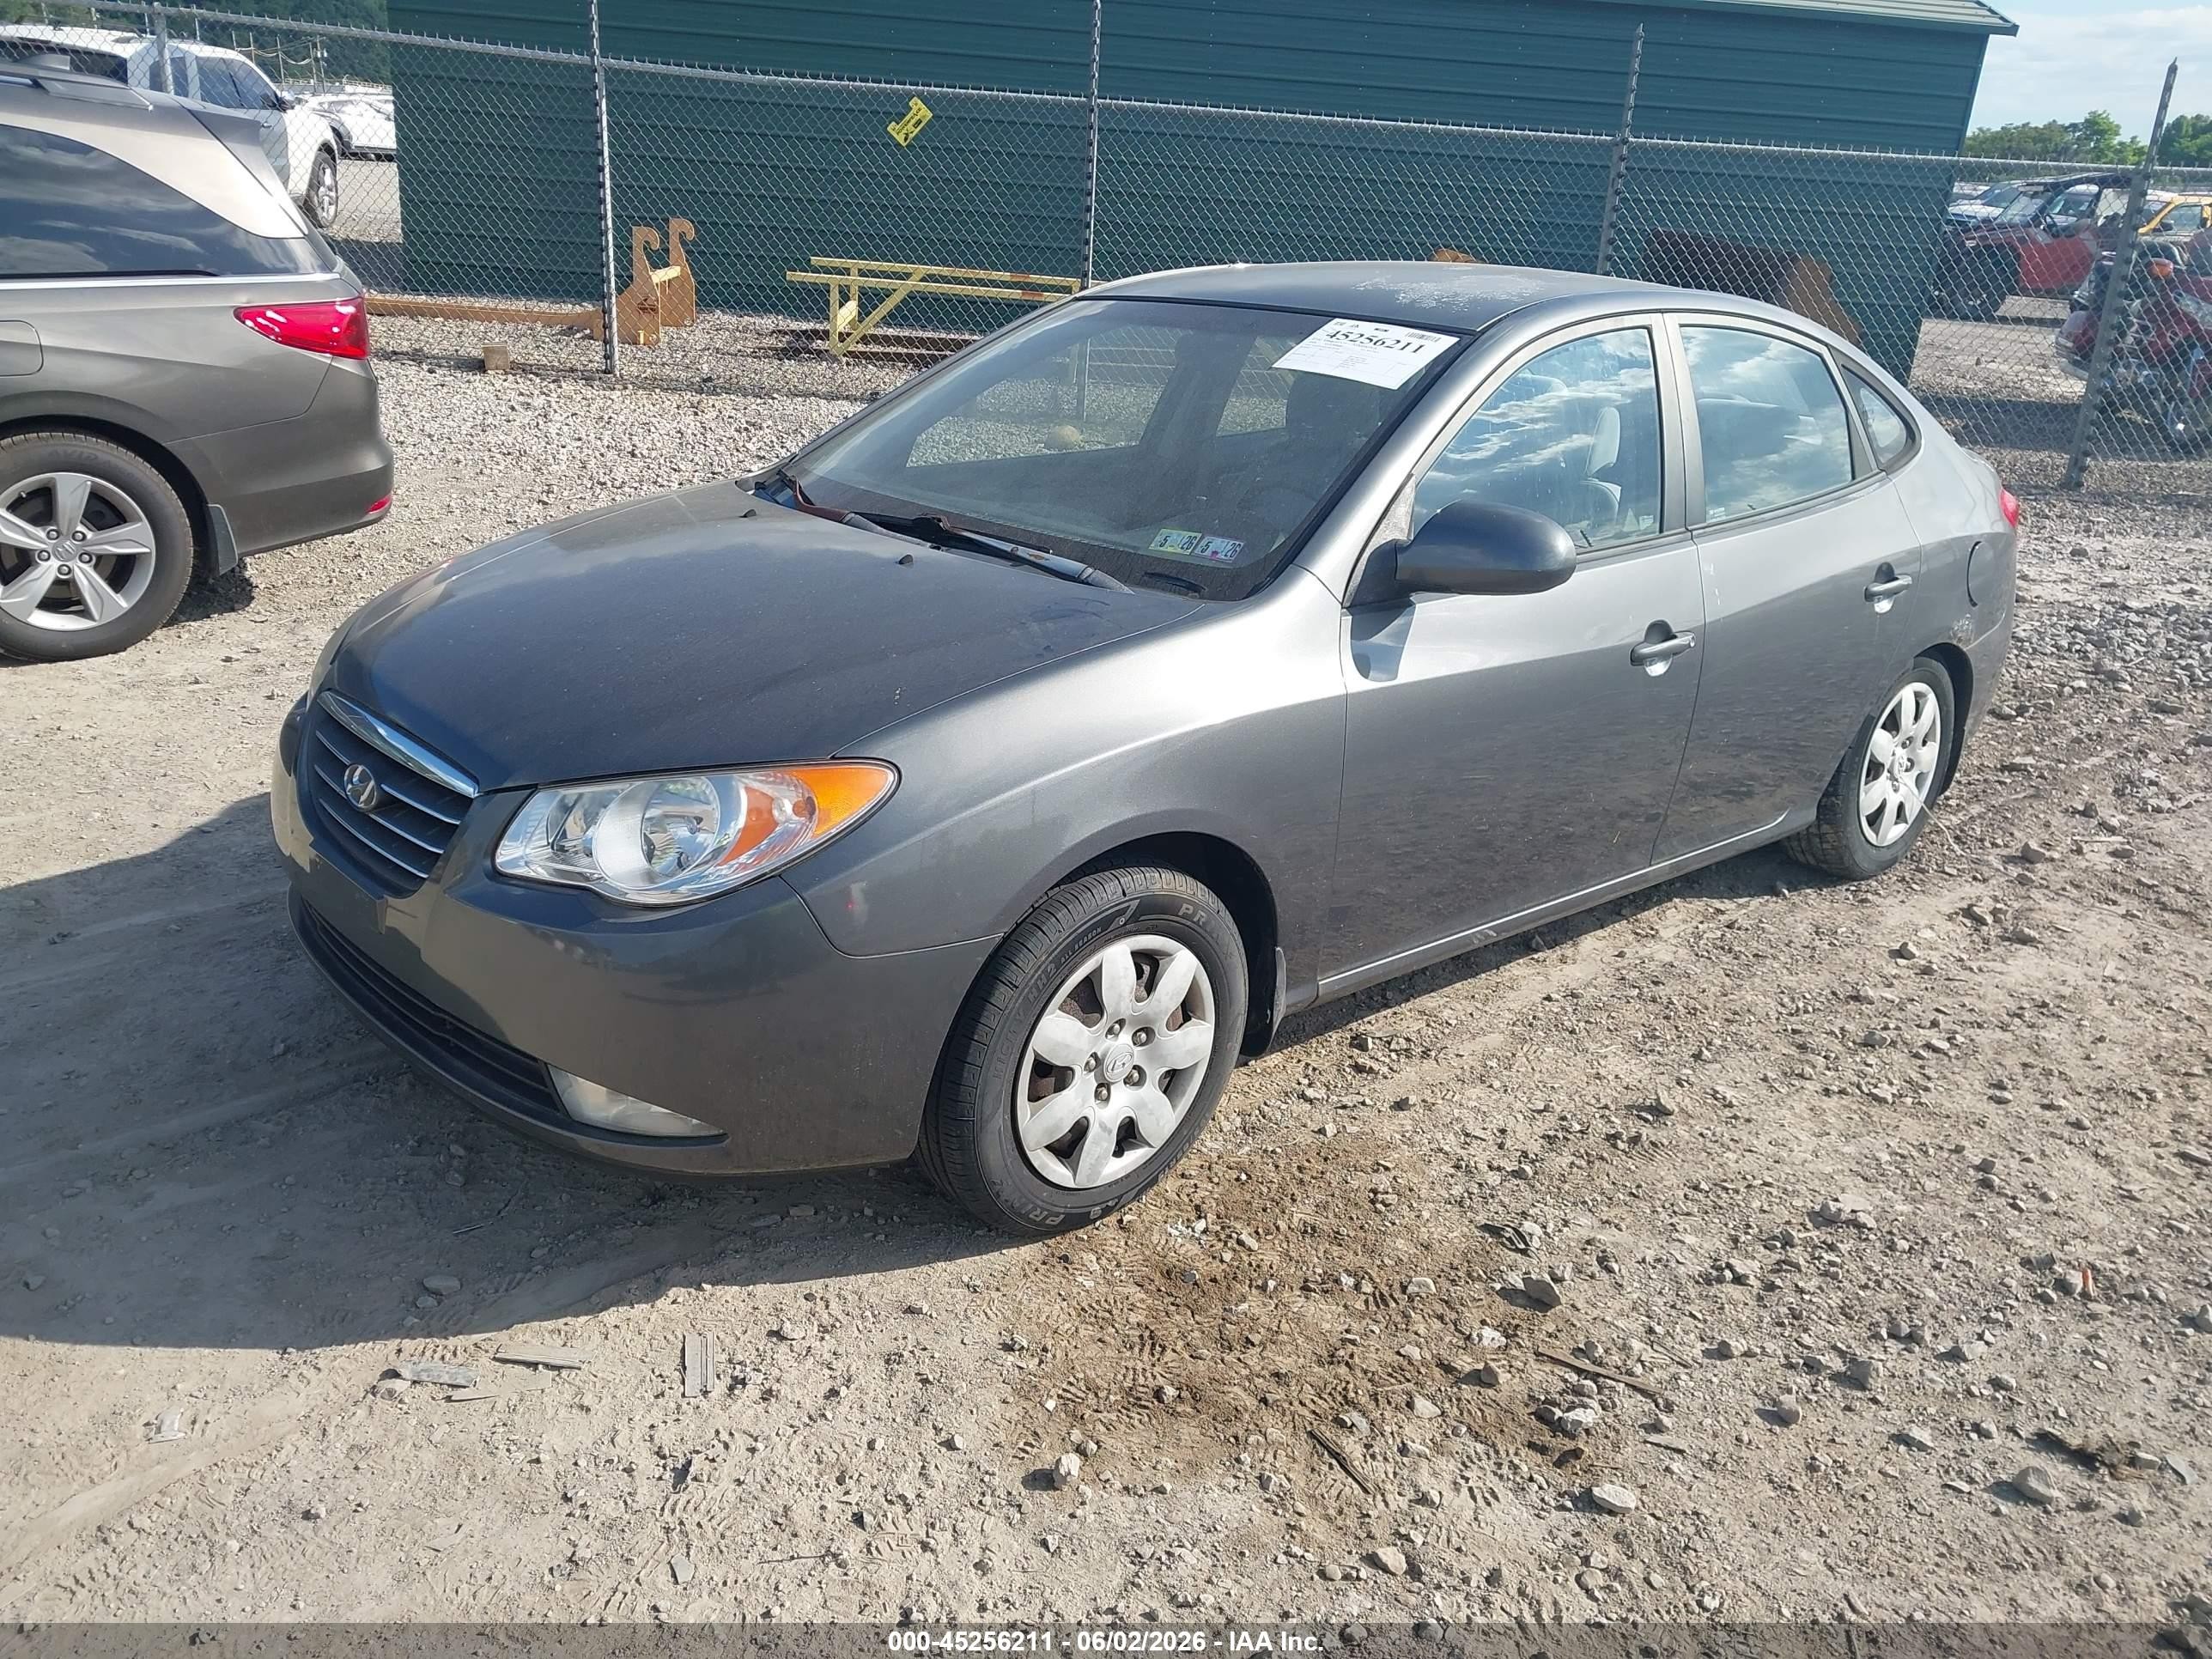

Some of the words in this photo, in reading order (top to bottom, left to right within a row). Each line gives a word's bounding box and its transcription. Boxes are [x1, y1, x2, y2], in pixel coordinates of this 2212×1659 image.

[1326, 330, 1425, 354] 45256211
[1224, 542, 1241, 558] 26
[1060, 950, 1073, 963] ALL
[1074, 927, 1103, 949] SEASON
